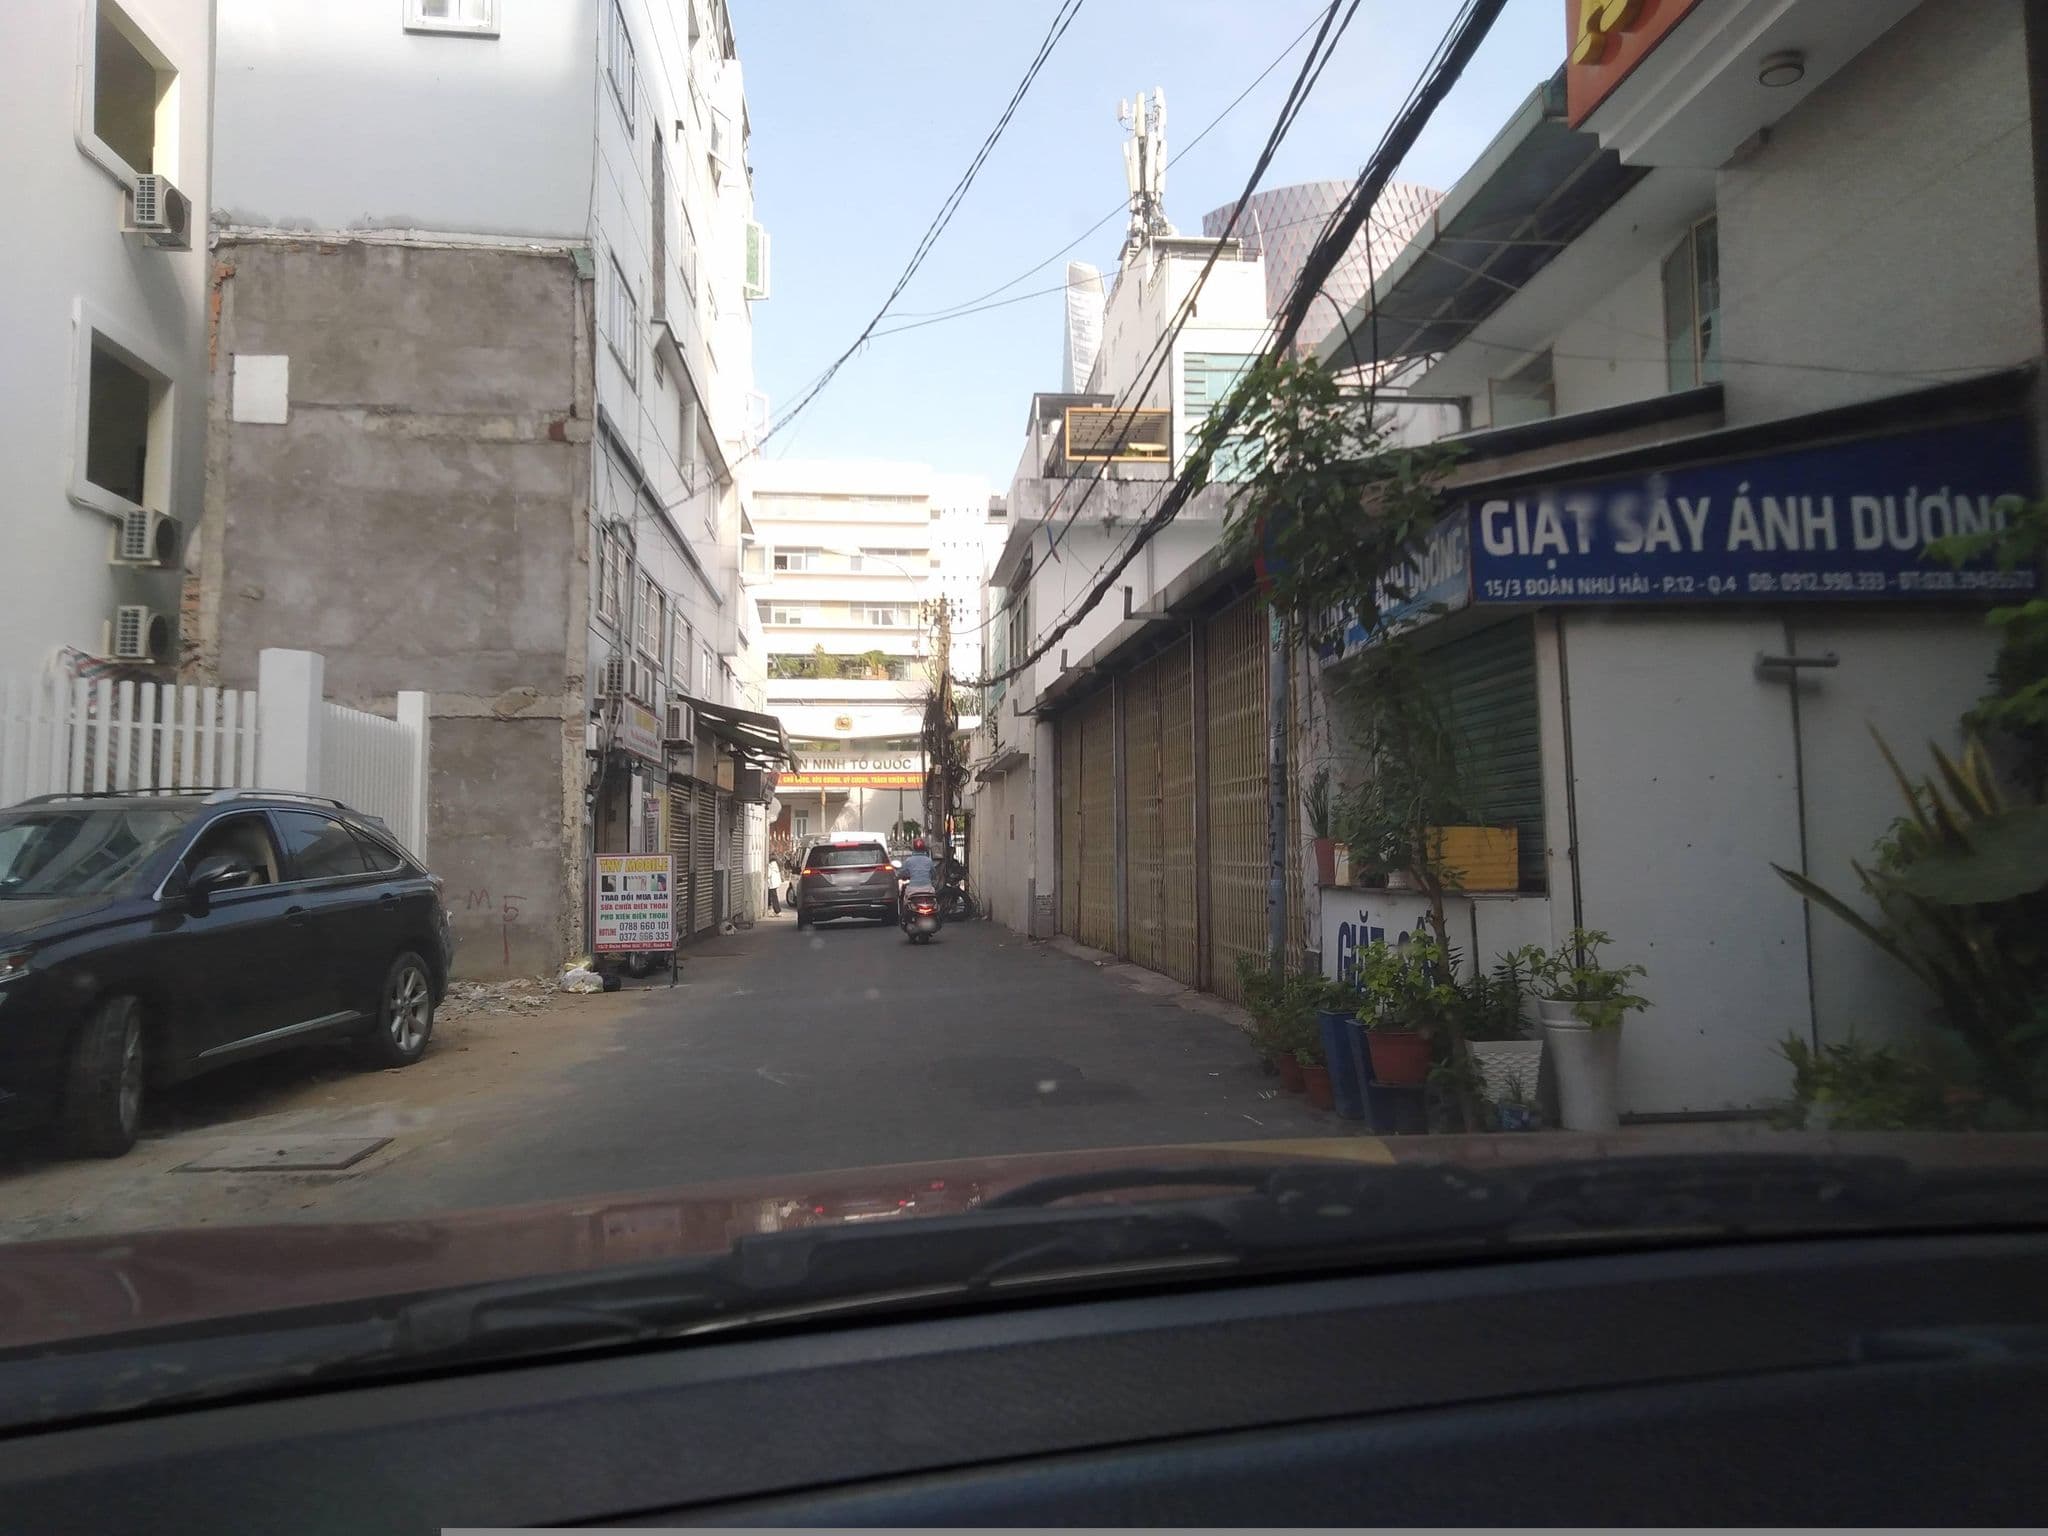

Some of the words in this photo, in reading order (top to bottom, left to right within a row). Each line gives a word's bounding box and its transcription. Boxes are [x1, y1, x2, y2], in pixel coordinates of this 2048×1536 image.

[1726, 481, 1839, 552] ÁNH
[1484, 578, 1522, 598] 15/3
[813, 759, 846, 770] NINH
[619, 922, 638, 931] 0788
[640, 921, 655, 931] 660
[657, 921, 669, 930] 101
[619, 932, 637, 942] 0372
[655, 931, 669, 940] 335
